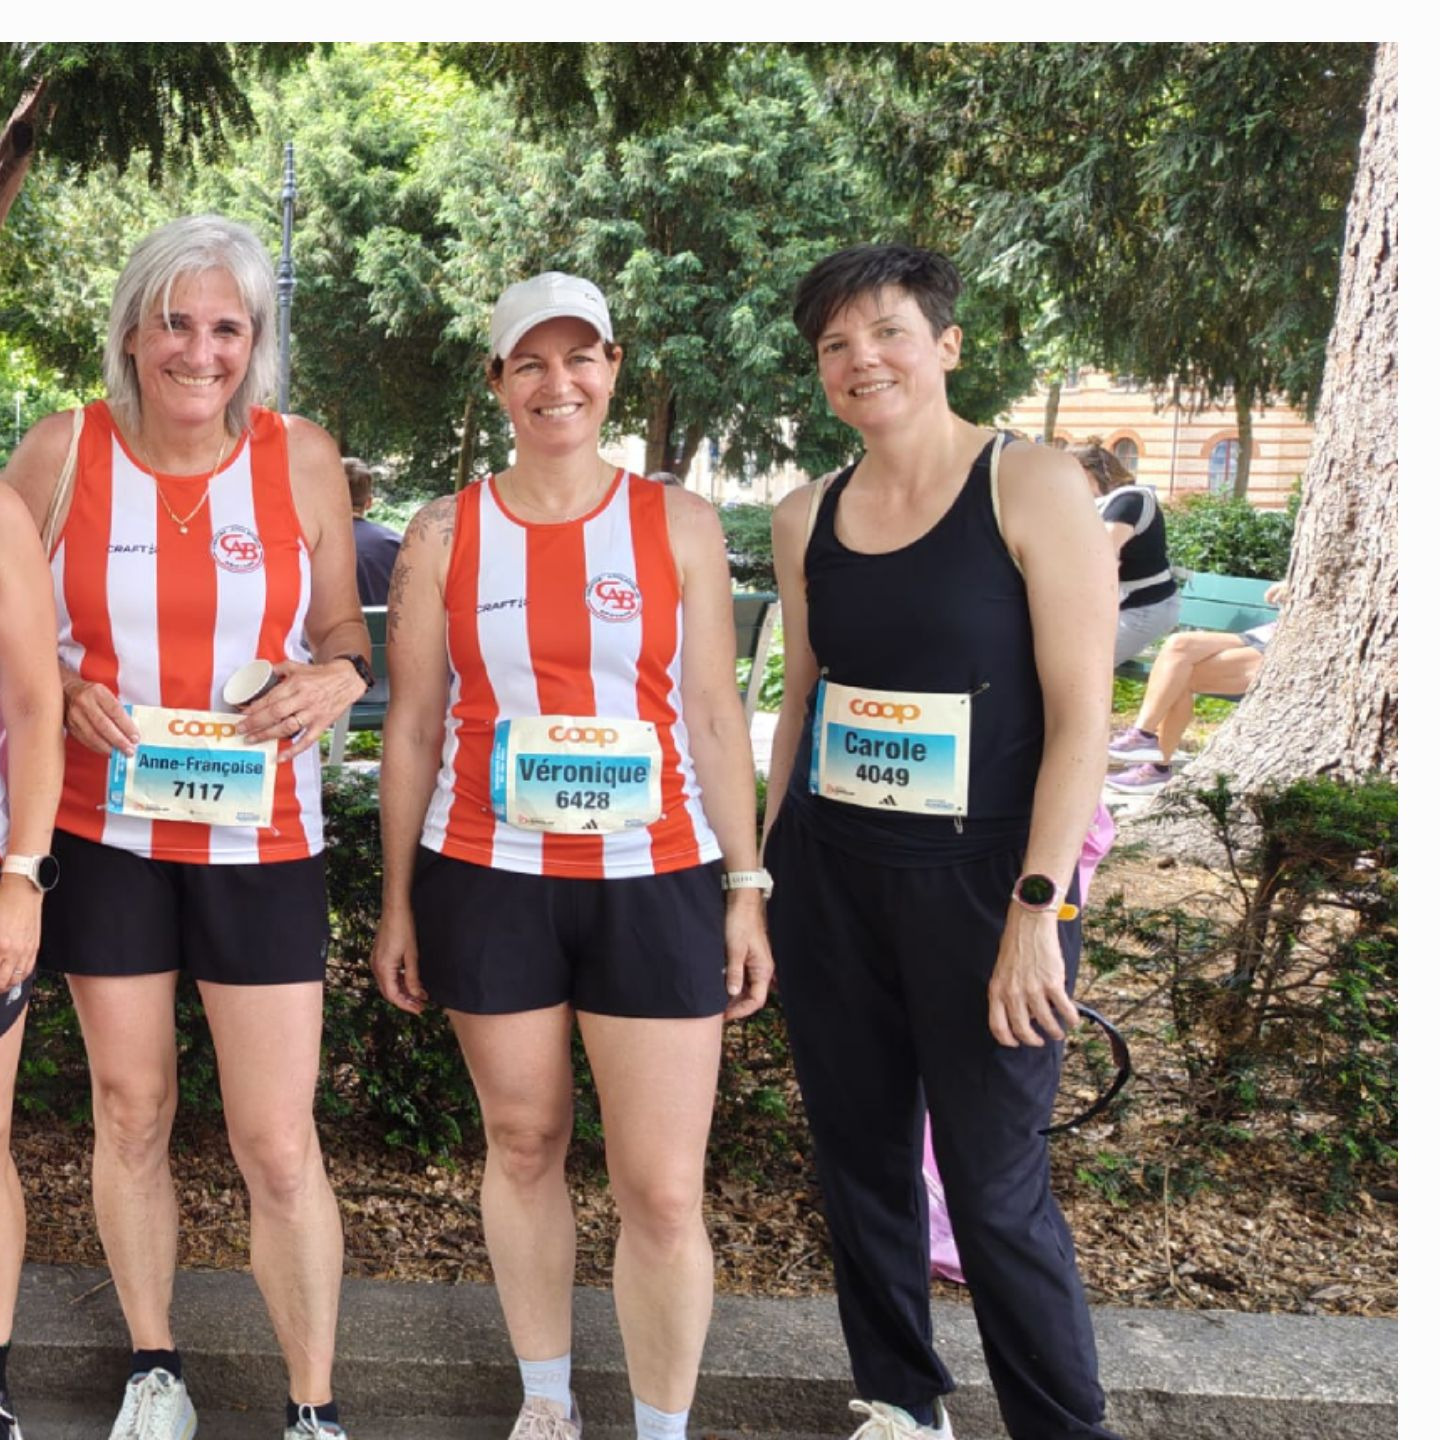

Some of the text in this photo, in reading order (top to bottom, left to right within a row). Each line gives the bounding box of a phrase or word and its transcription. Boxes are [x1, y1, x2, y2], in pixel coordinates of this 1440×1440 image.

[107, 544, 148, 553] CRAFT
[220, 534, 258, 560] CAB
[475, 599, 519, 614] CRAFT
[594, 580, 636, 610] CAB
[849, 699, 921, 724] coop
[168, 719, 237, 741] coop
[548, 725, 619, 747] coop
[845, 731, 927, 762] Carole
[138, 753, 264, 778] Anne-Françoise
[519, 758, 647, 788] Véronique
[856, 764, 910, 787] 4049
[173, 781, 224, 801] 7117
[556, 791, 610, 809] 6428
